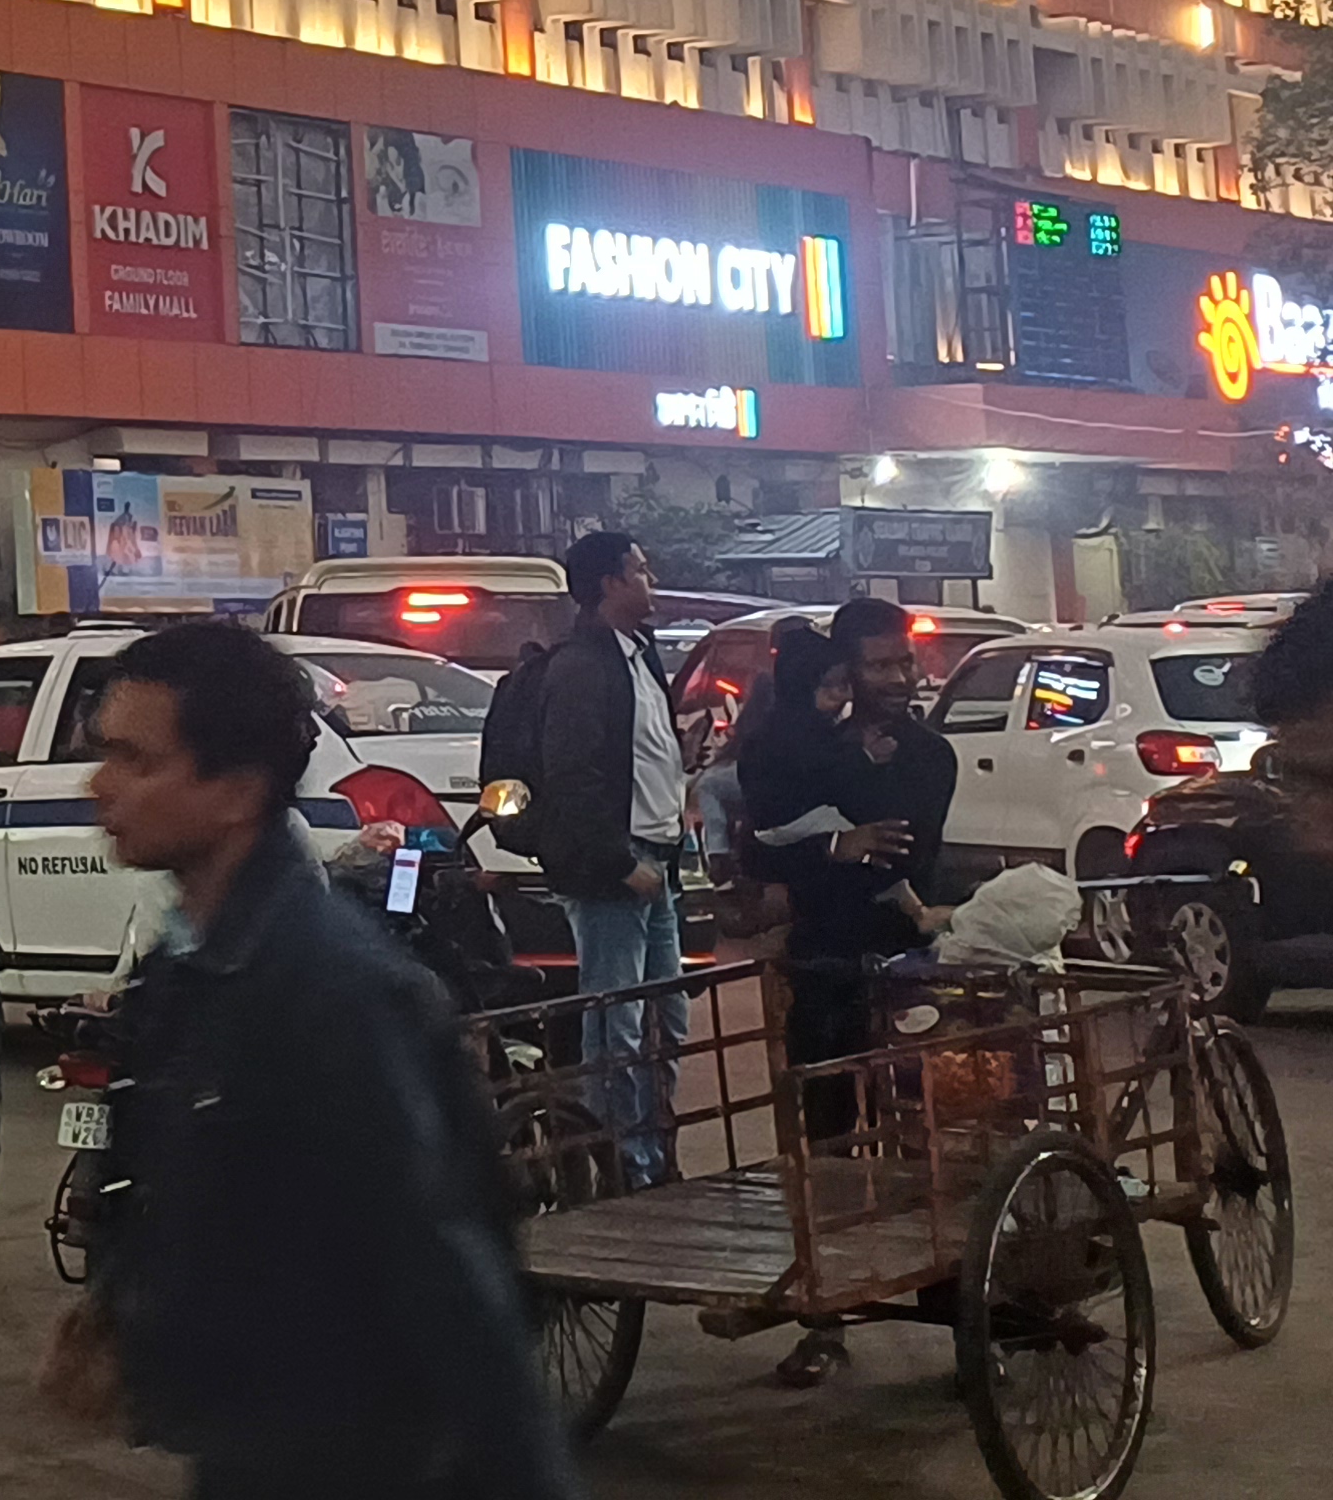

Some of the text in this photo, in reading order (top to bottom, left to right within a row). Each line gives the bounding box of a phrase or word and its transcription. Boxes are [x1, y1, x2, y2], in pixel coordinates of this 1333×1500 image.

[92, 204, 209, 250] KHADIM
[544, 222, 712, 306] FASHION
[717, 244, 796, 315] CITY
[104, 290, 198, 319] FAMILY MALL
[17, 856, 109, 876] NO REFUSAL
